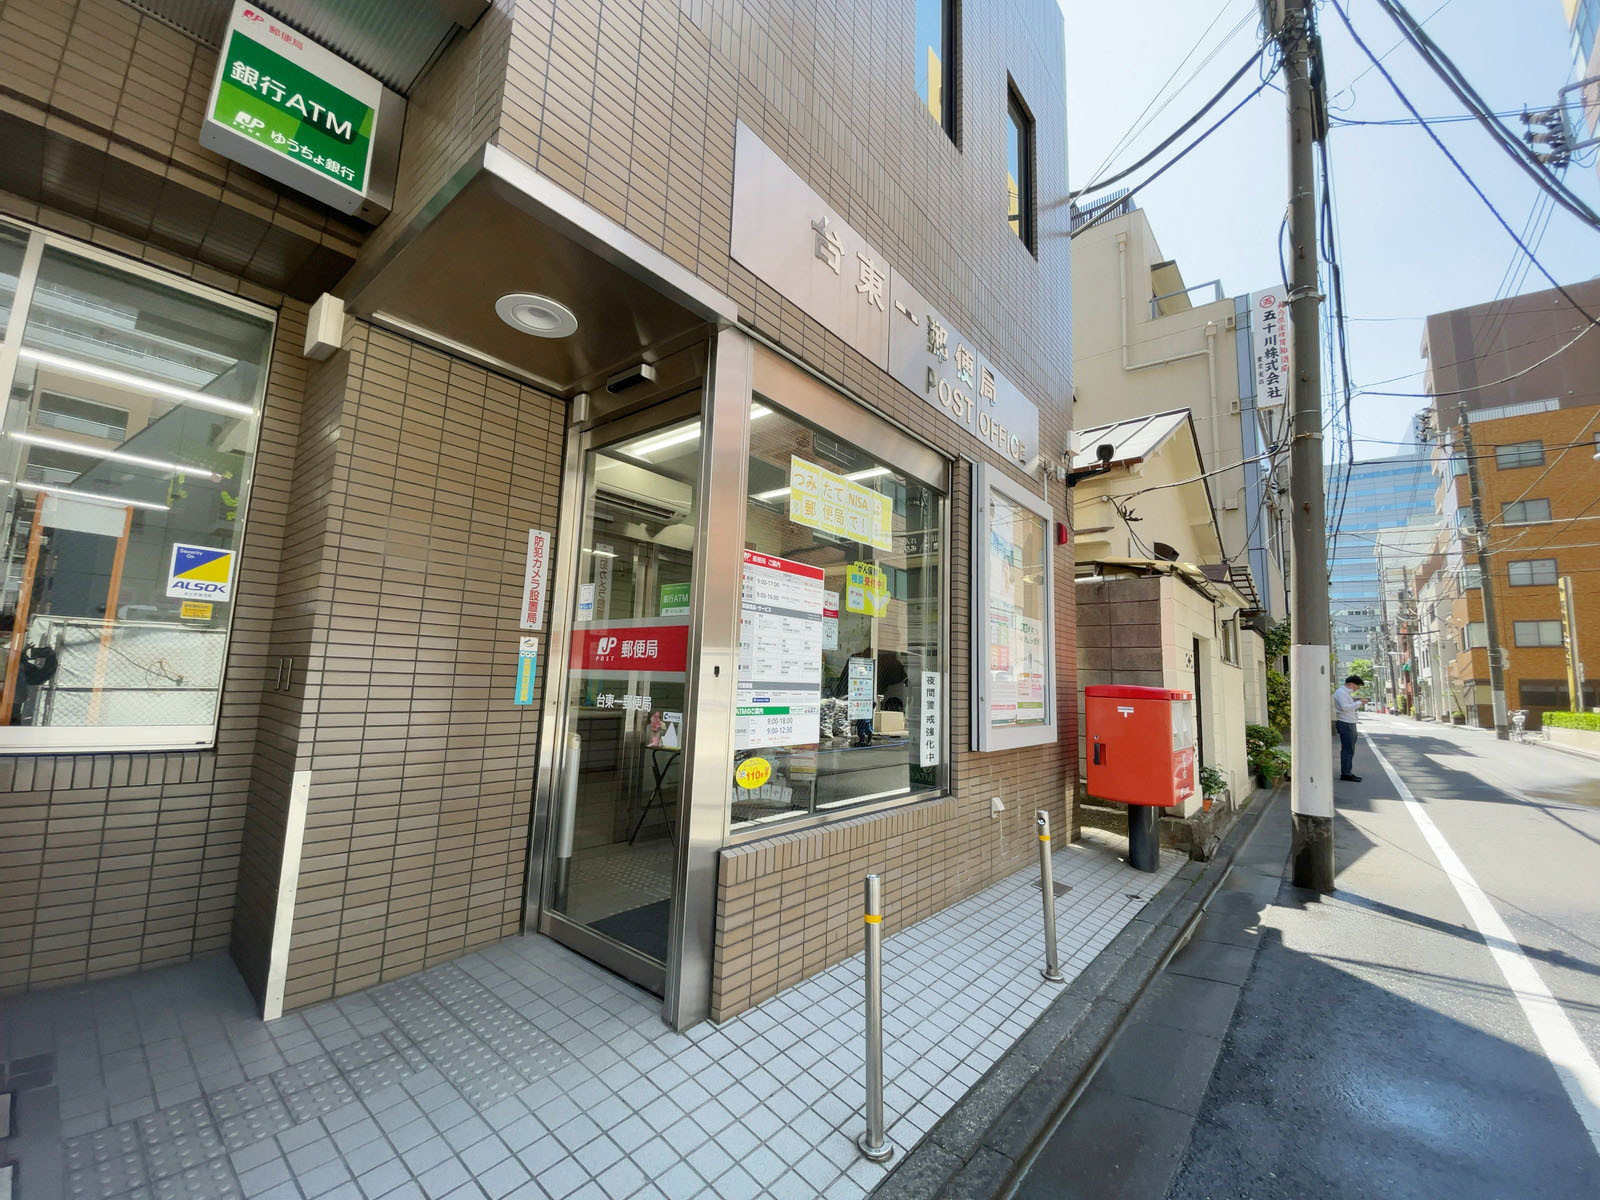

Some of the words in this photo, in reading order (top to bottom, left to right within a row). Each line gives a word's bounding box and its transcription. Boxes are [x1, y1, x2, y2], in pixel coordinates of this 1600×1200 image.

[268, 25, 304, 51] 郵便局
[230, 60, 353, 140] 銀行ATM
[270, 130, 356, 181] ゆうちょ銀行
[811, 215, 1000, 407] 台東一郵便局
[1262, 309, 1283, 399] 五十川株式会社
[926, 366, 975, 424] POST
[978, 410, 1027, 466] OFFICE
[172, 580, 227, 594] ALSOK
[526, 535, 545, 624] 防犯カメラ設置局
[621, 639, 658, 659] 郵便局
[596, 693, 652, 712] 台東一郵便局
[924, 675, 936, 763] 夜間警戒強化中
